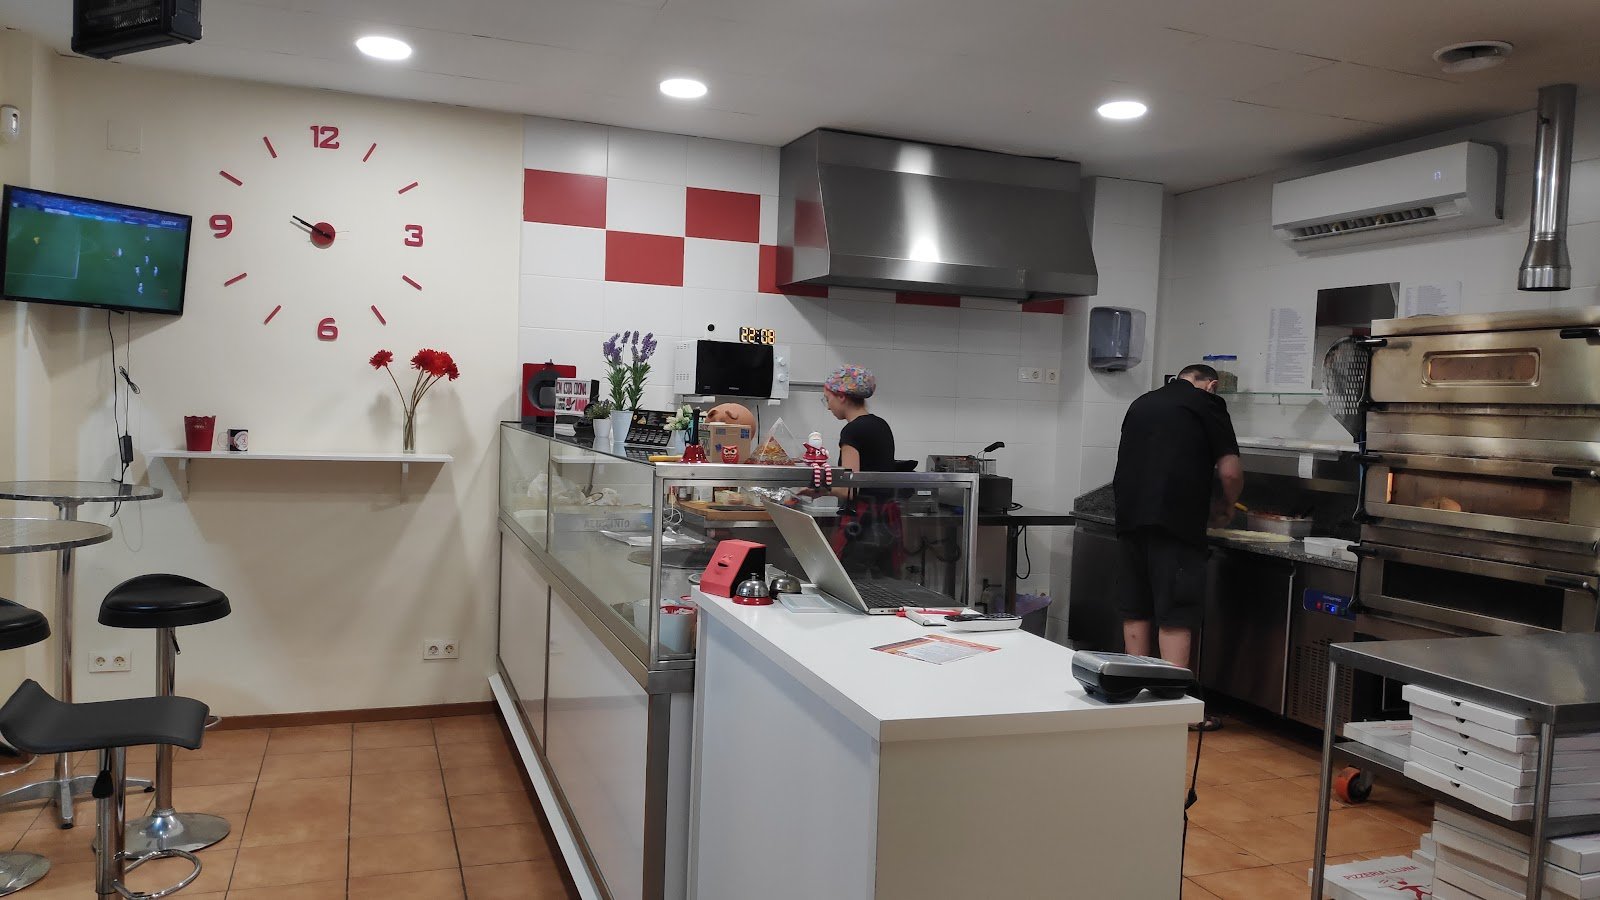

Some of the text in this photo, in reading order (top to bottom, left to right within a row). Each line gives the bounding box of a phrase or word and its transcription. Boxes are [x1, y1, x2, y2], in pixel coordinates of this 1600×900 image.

[310, 125, 340, 149] 12
[209, 214, 233, 239] 9
[404, 224, 424, 247] 3
[317, 317, 338, 341] 6
[741, 327, 775, 345] 22:08
[1343, 870, 1385, 880] PIZZERIA
